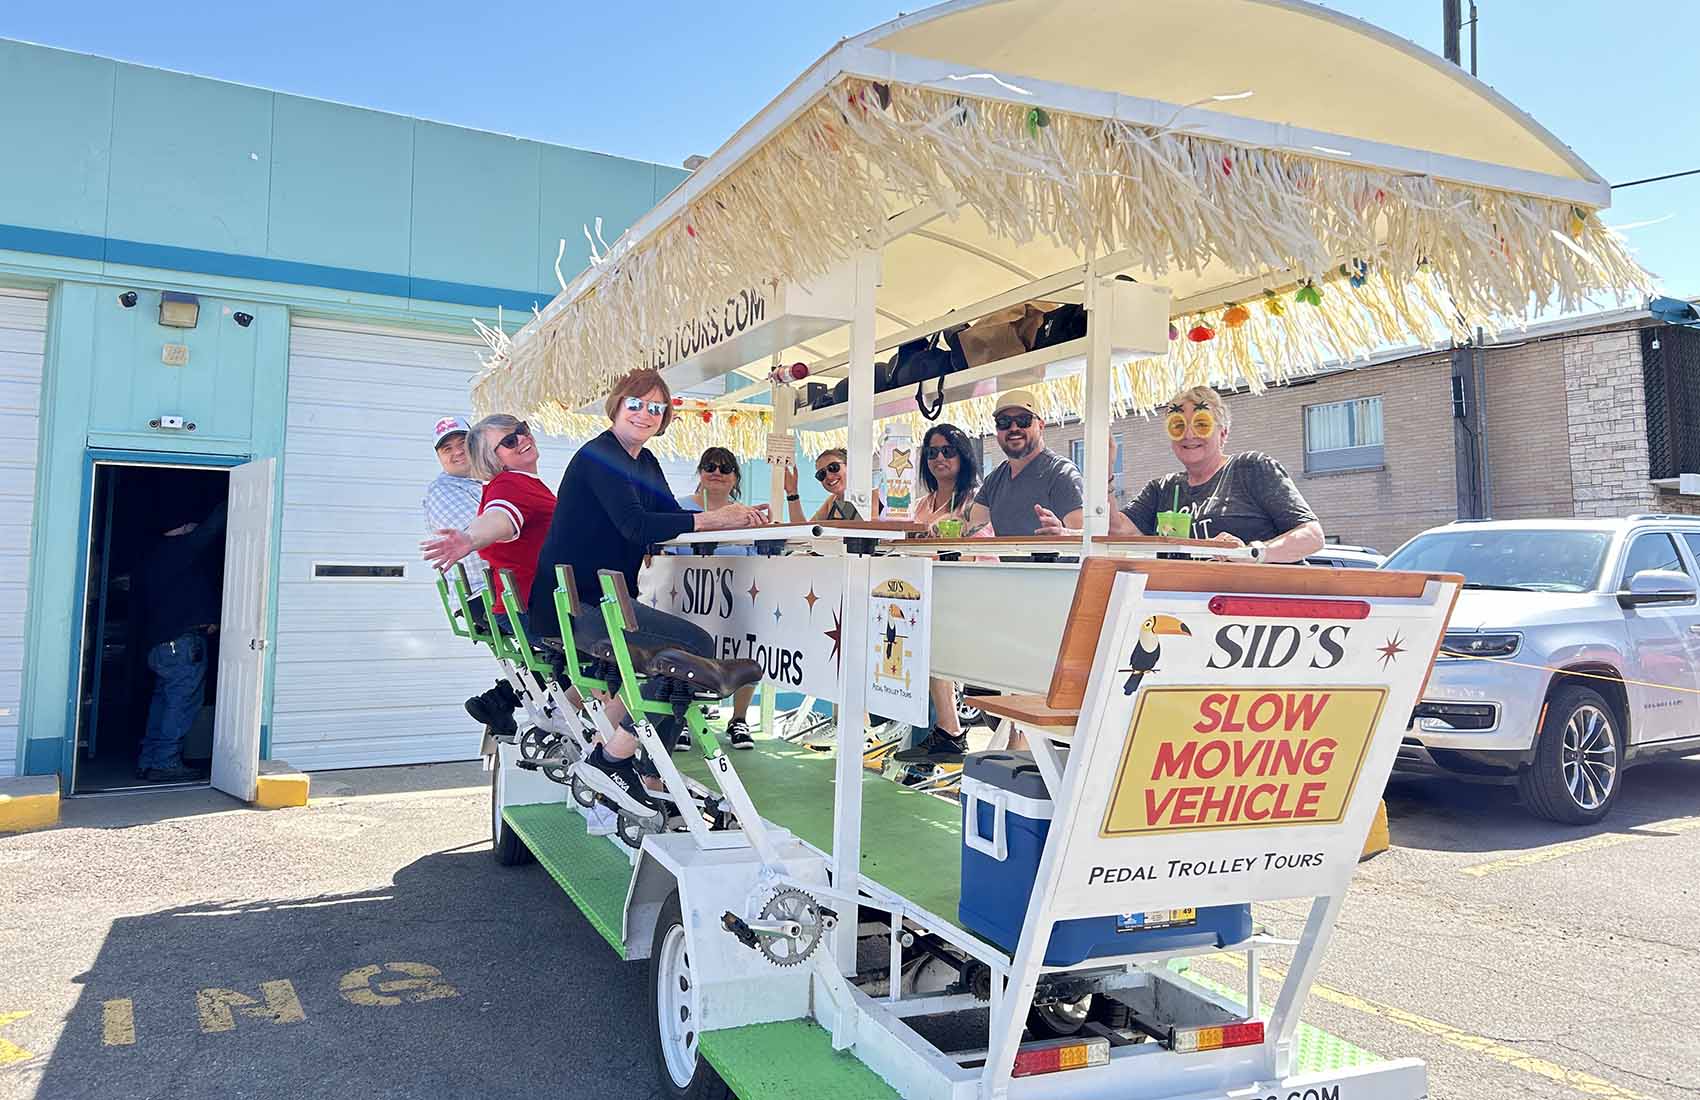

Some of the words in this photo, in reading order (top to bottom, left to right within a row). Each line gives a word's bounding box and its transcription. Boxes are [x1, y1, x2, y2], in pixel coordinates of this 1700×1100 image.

[682, 567, 734, 619] SID'S
[887, 580, 904, 593] SID'S
[746, 633, 803, 686] TOURS
[1206, 624, 1351, 669] SID'S
[552, 682, 558, 692] 3
[592, 702, 598, 712] 4
[1193, 693, 1330, 733] SLOW
[644, 726, 652, 738] 5
[719, 757, 728, 773] 6
[1151, 737, 1338, 781] MOVING
[610, 772, 631, 792] HOKA
[1144, 782, 1327, 826] VEHICLE
[1088, 866, 1158, 885] PEDAL
[1167, 857, 1257, 878] TROLLEY
[1264, 852, 1324, 870] TOURS
[1183, 907, 1192, 915] 49
